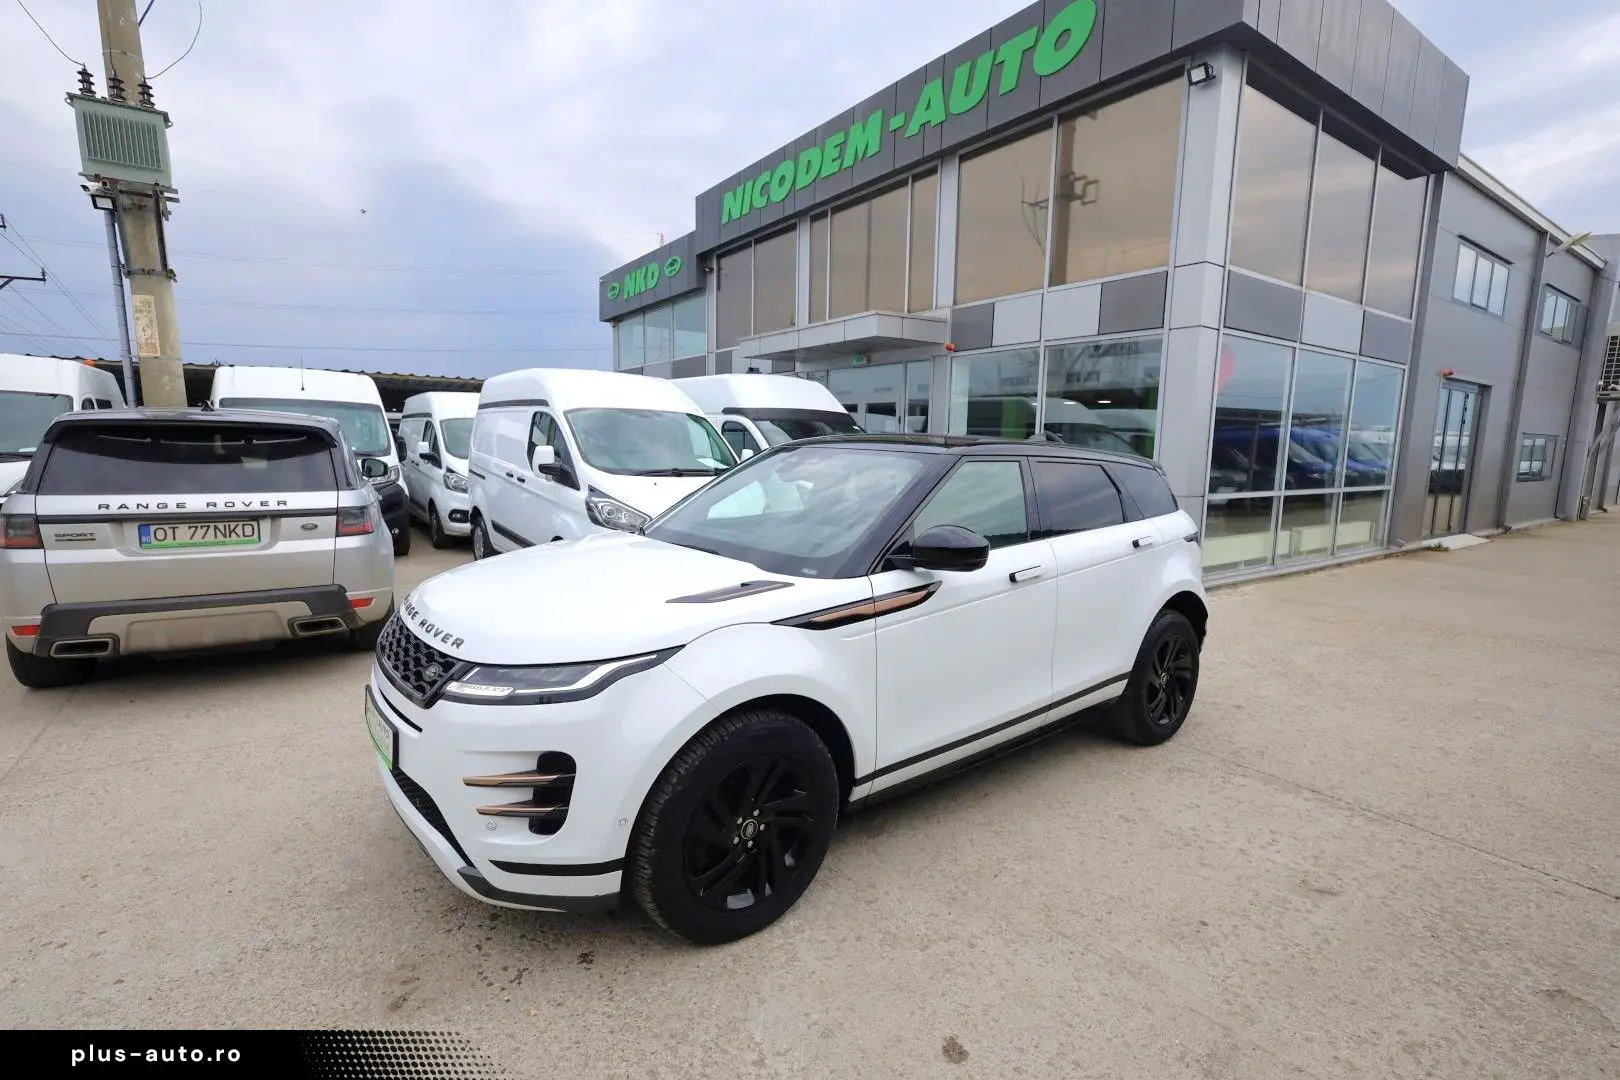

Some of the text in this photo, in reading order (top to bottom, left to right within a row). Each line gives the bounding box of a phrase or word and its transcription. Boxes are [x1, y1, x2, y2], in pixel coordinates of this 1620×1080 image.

[720, 0, 1097, 225] NICODEM-AUTO
[623, 262, 660, 300] NKD
[98, 500, 288, 511] RANGE ROVER
[153, 526, 179, 542] OT
[418, 618, 465, 650] ROVER
